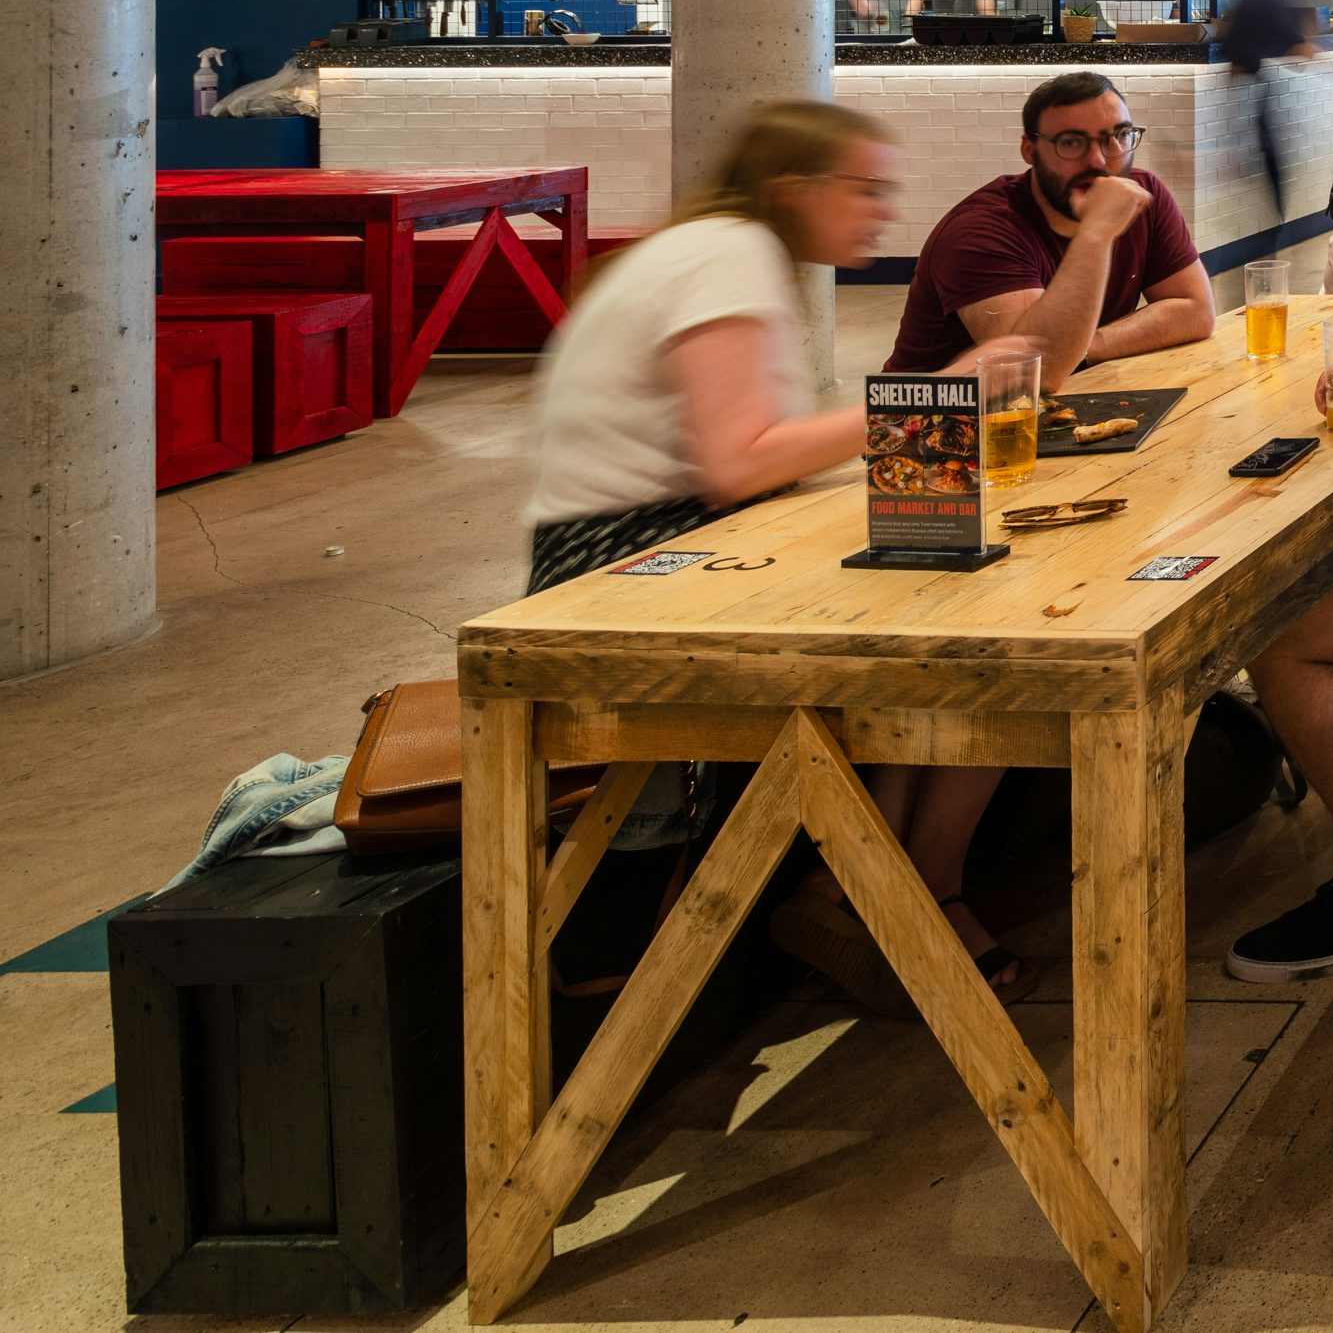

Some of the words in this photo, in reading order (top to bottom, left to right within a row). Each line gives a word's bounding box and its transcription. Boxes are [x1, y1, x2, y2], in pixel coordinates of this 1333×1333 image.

[869, 383, 933, 406] SHELTER
[937, 384, 976, 407] HALL
[872, 501, 895, 515] FOOD
[897, 502, 935, 515] MARKET
[938, 502, 957, 515] AND
[959, 503, 977, 516] BAR
